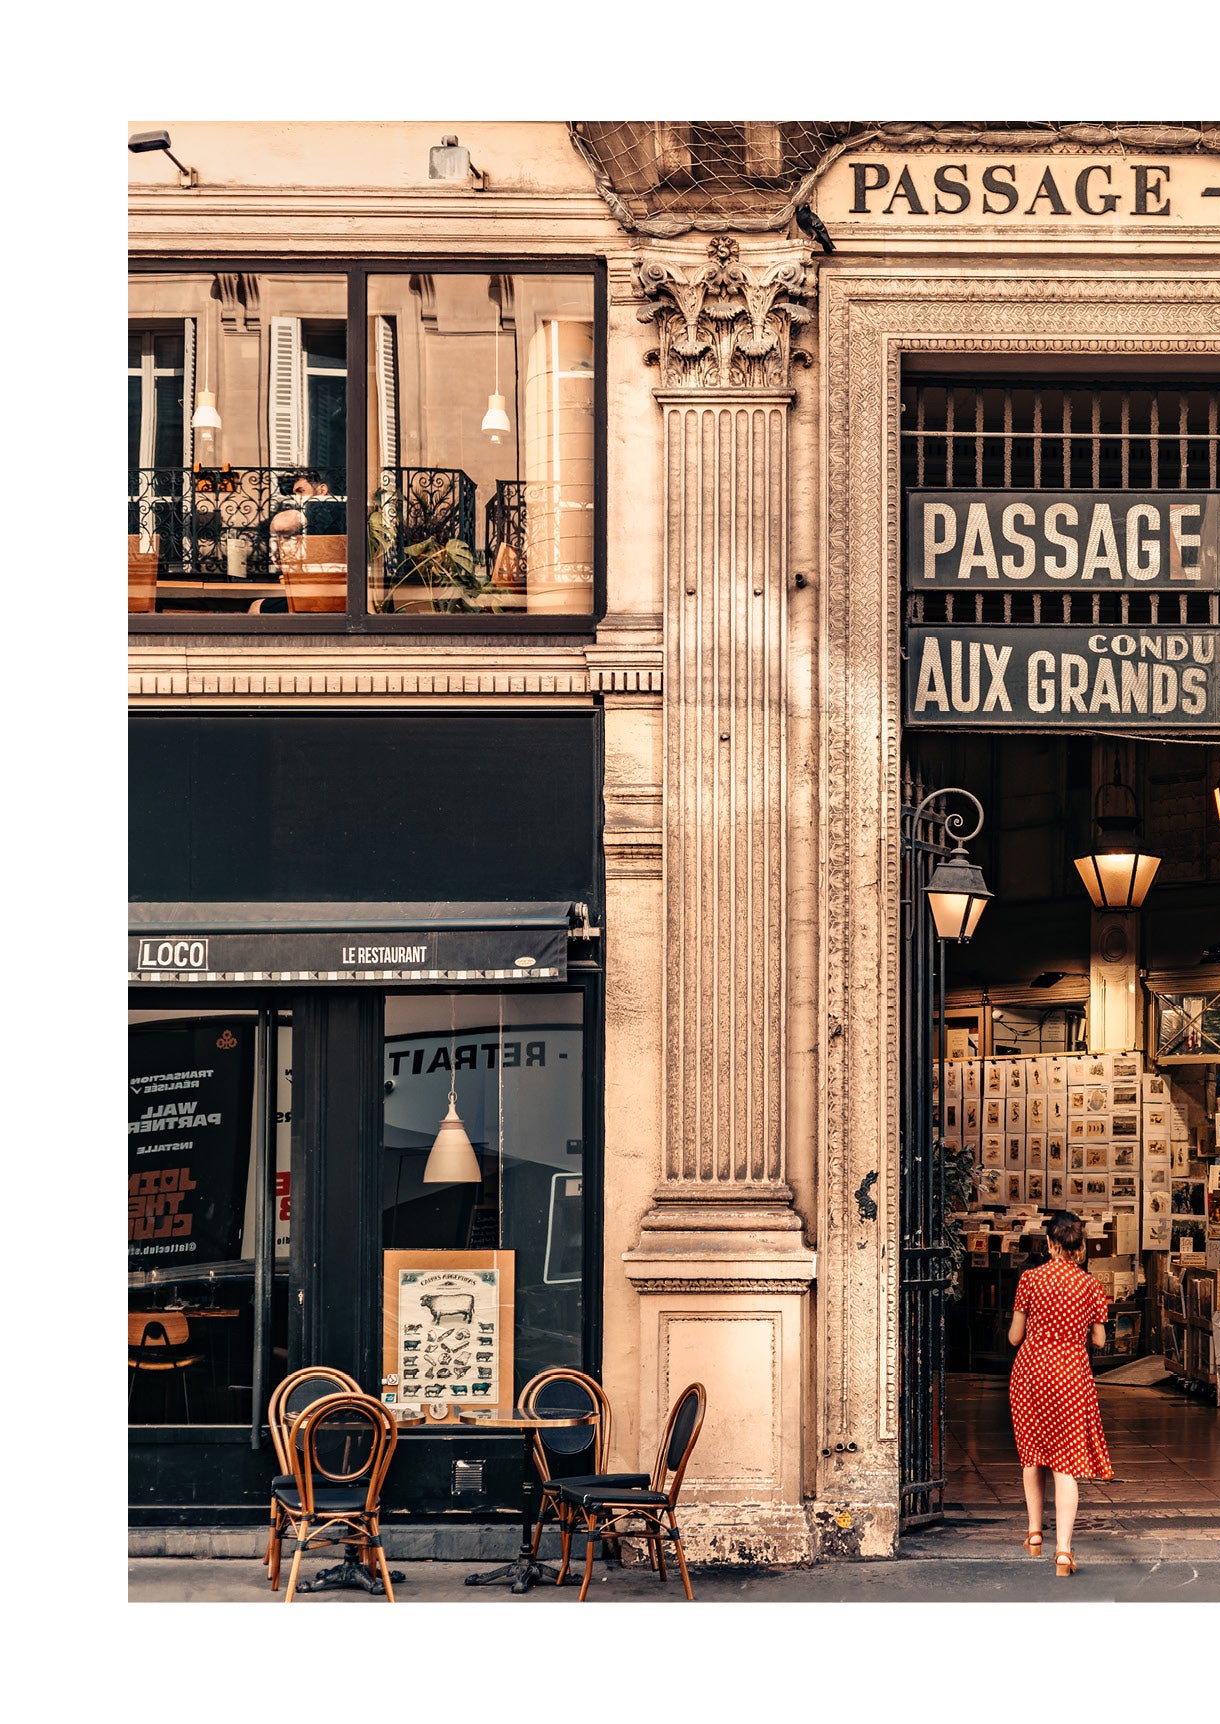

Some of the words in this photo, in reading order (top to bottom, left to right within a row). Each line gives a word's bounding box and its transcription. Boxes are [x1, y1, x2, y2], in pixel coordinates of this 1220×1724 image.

[849, 163, 1171, 215] PASSAGE
[923, 502, 1201, 581] PASSAGE
[914, 636, 1013, 712] AUX
[1027, 649, 1207, 714] GRANDS
[142, 941, 204, 967] LOCO
[342, 947, 357, 964] LE
[358, 946, 427, 963] RESTAURANT
